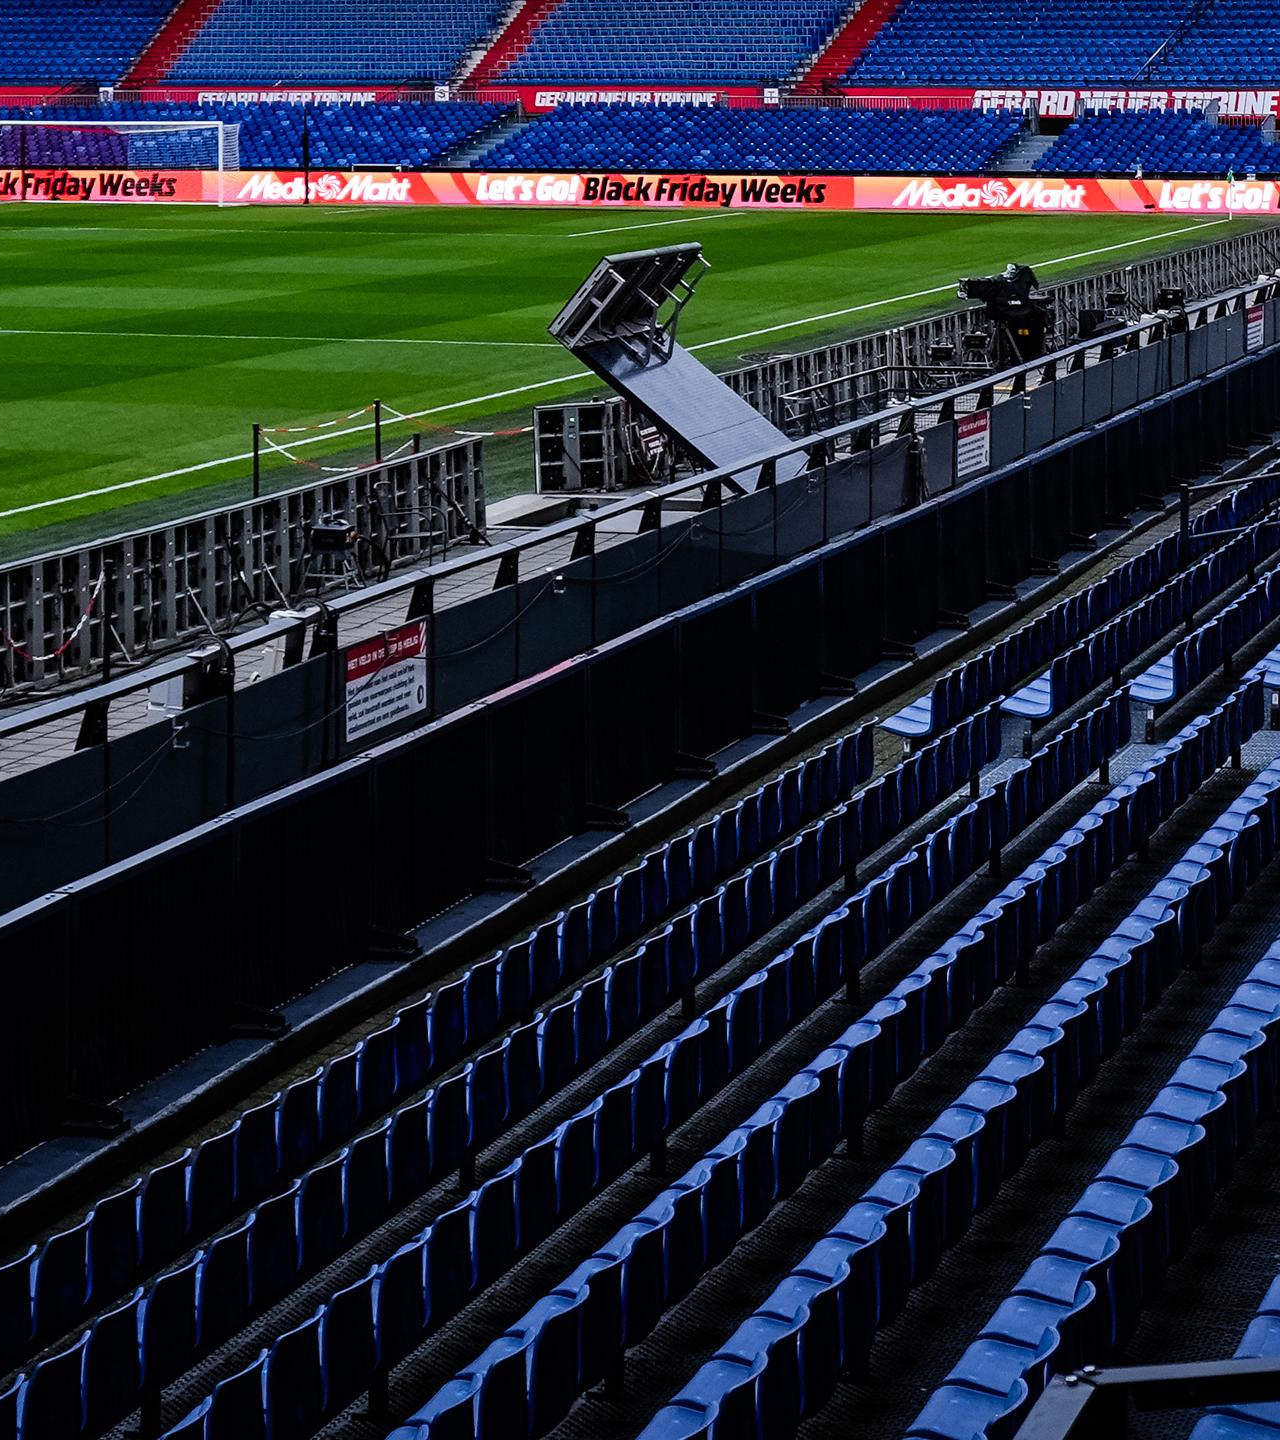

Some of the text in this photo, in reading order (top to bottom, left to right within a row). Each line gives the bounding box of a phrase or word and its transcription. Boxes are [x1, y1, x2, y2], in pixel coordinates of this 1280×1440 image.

[23, 172, 96, 201] Friday
[99, 173, 177, 197] Weeks
[476, 175, 827, 207] Let's Go! Black Friday Weeks
[1158, 181, 1227, 210] Let's
[1227, 182, 1273, 210] Go!
